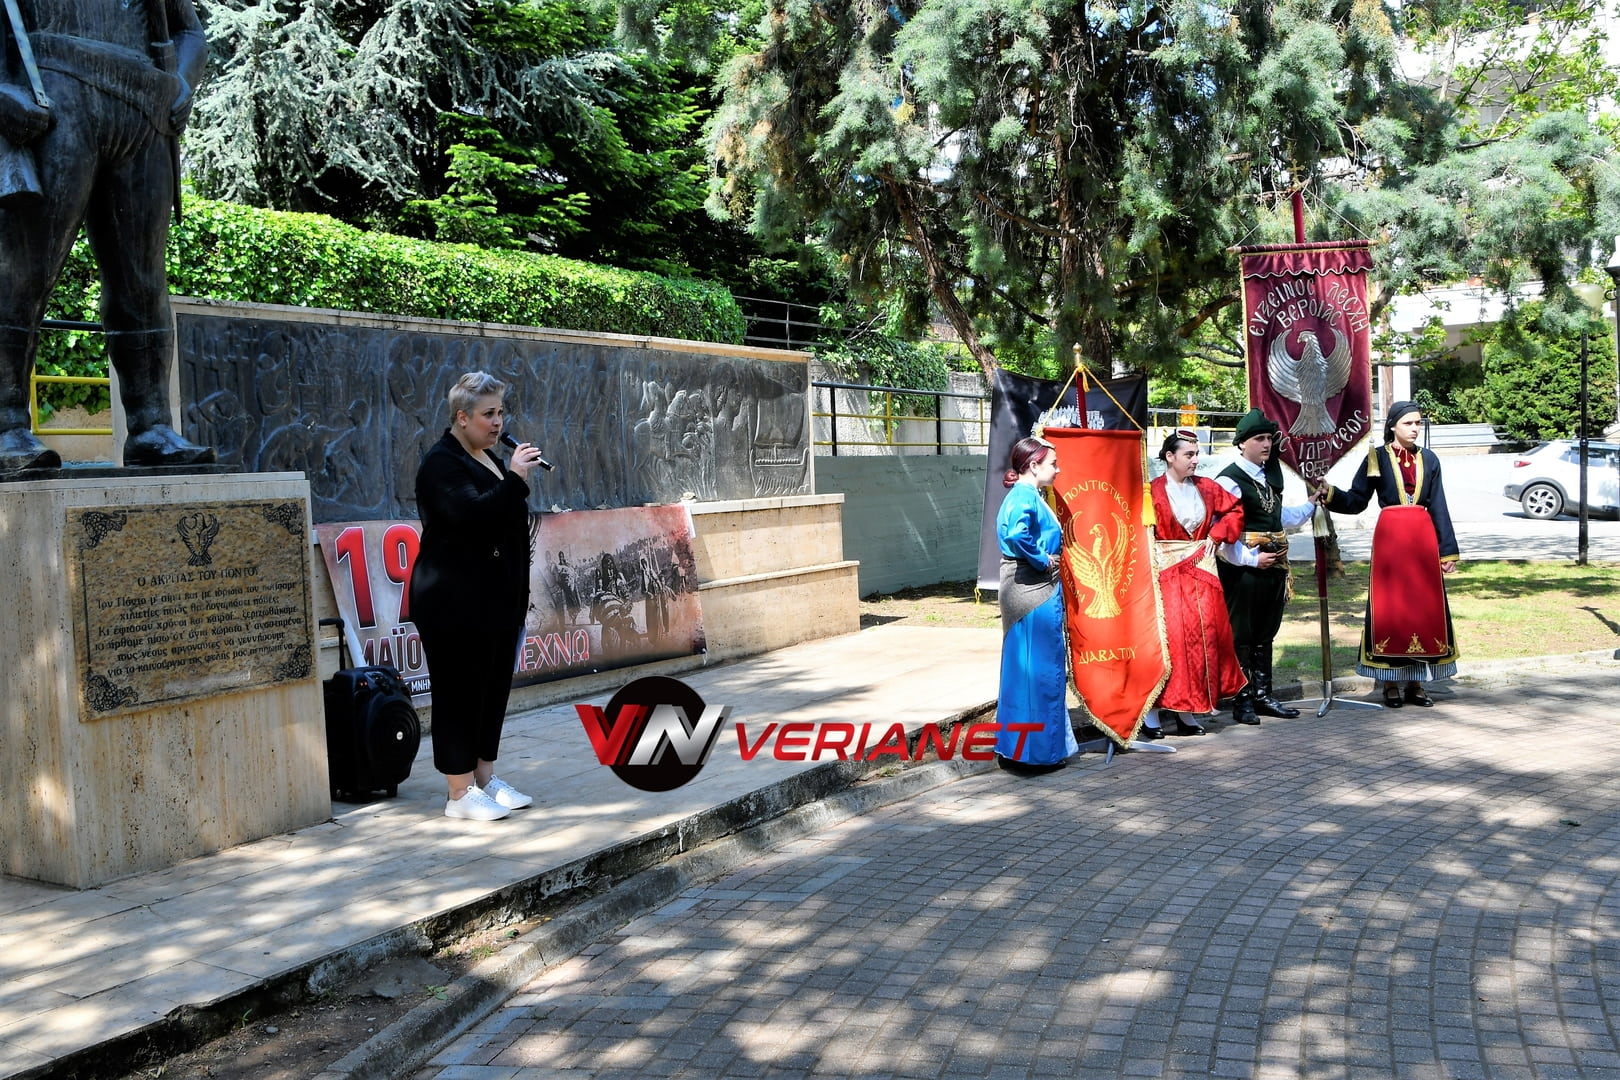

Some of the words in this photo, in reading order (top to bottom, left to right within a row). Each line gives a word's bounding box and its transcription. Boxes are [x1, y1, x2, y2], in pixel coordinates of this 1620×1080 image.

[1299, 458, 1330, 479] 1955
[198, 570, 216, 581] ΤΟΥ
[184, 590, 197, 600] και
[247, 584, 258, 592] τον
